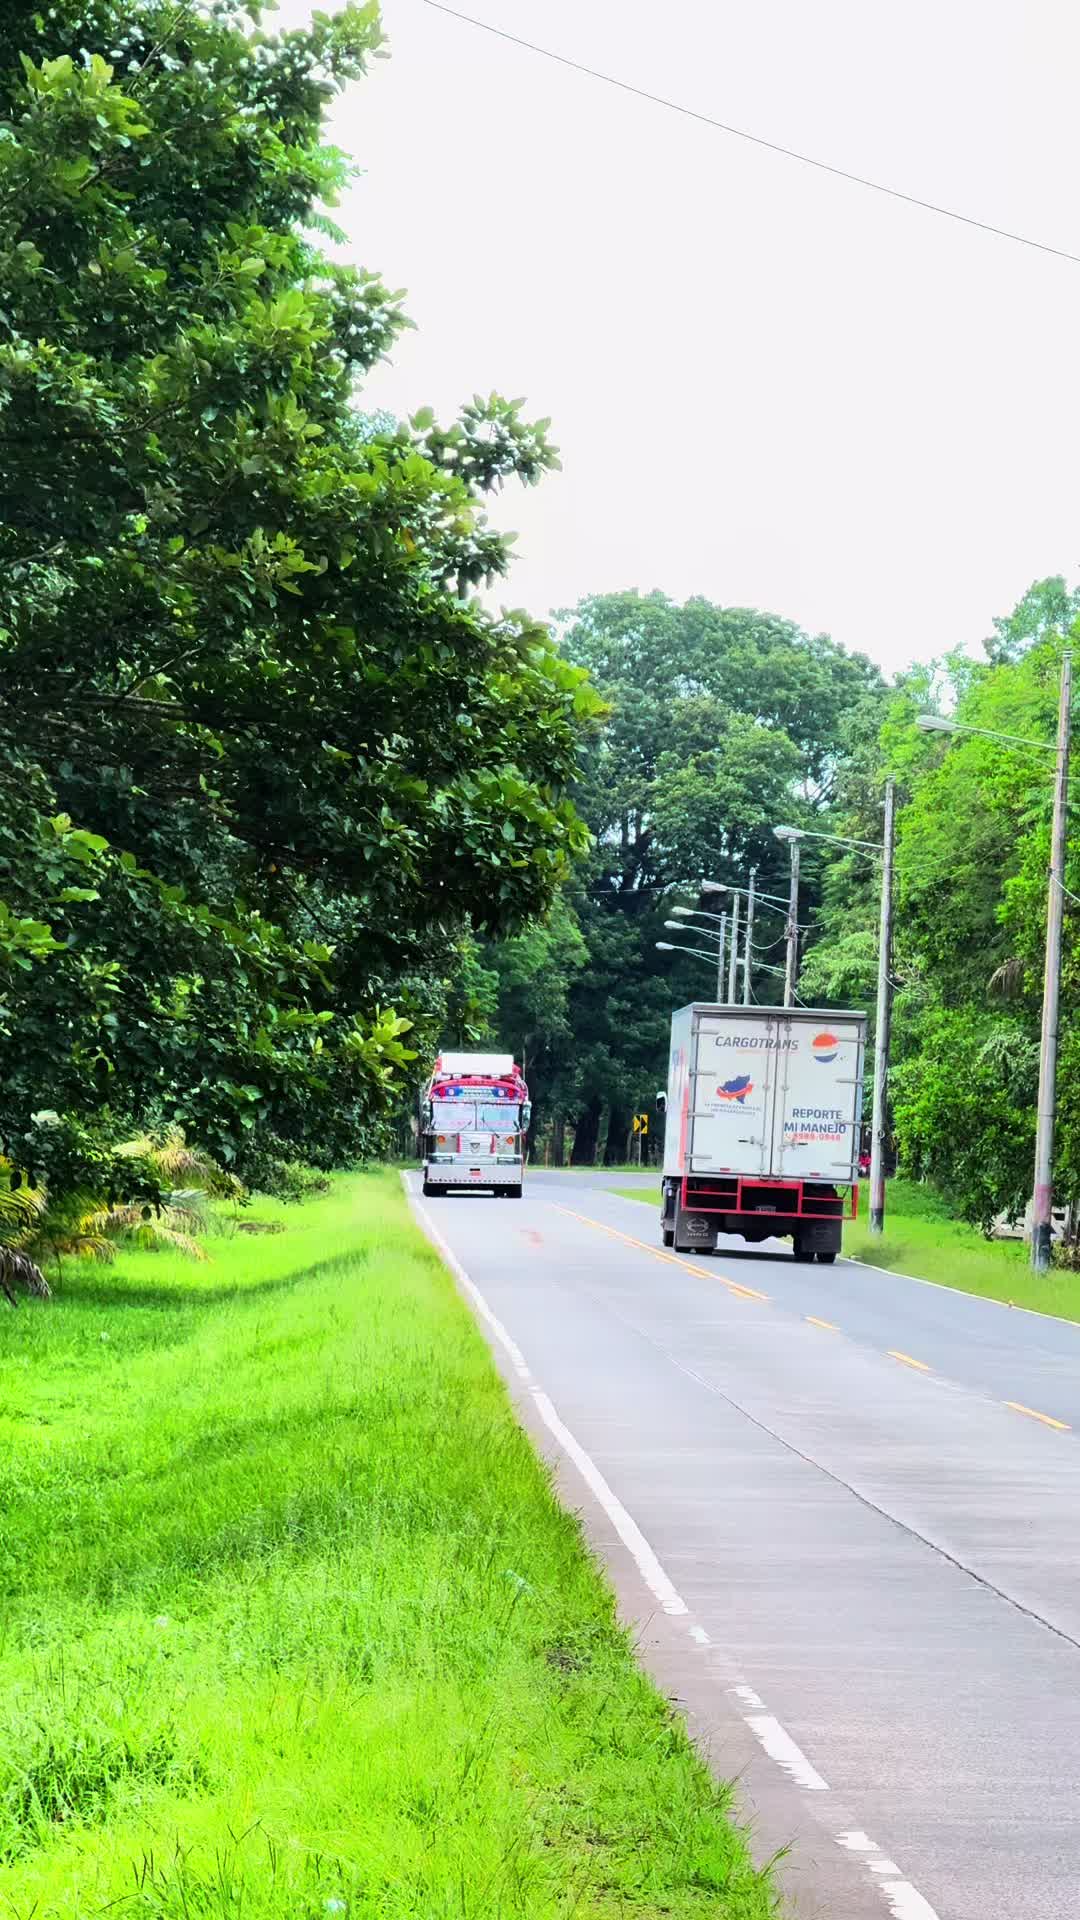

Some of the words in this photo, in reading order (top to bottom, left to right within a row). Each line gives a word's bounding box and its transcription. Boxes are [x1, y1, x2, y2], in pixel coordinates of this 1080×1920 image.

[715, 1036, 799, 1050] CARGOTRANS
[792, 1108, 843, 1120] REPORTE
[784, 1122, 798, 1132] MI
[800, 1122, 847, 1134] MANEJO
